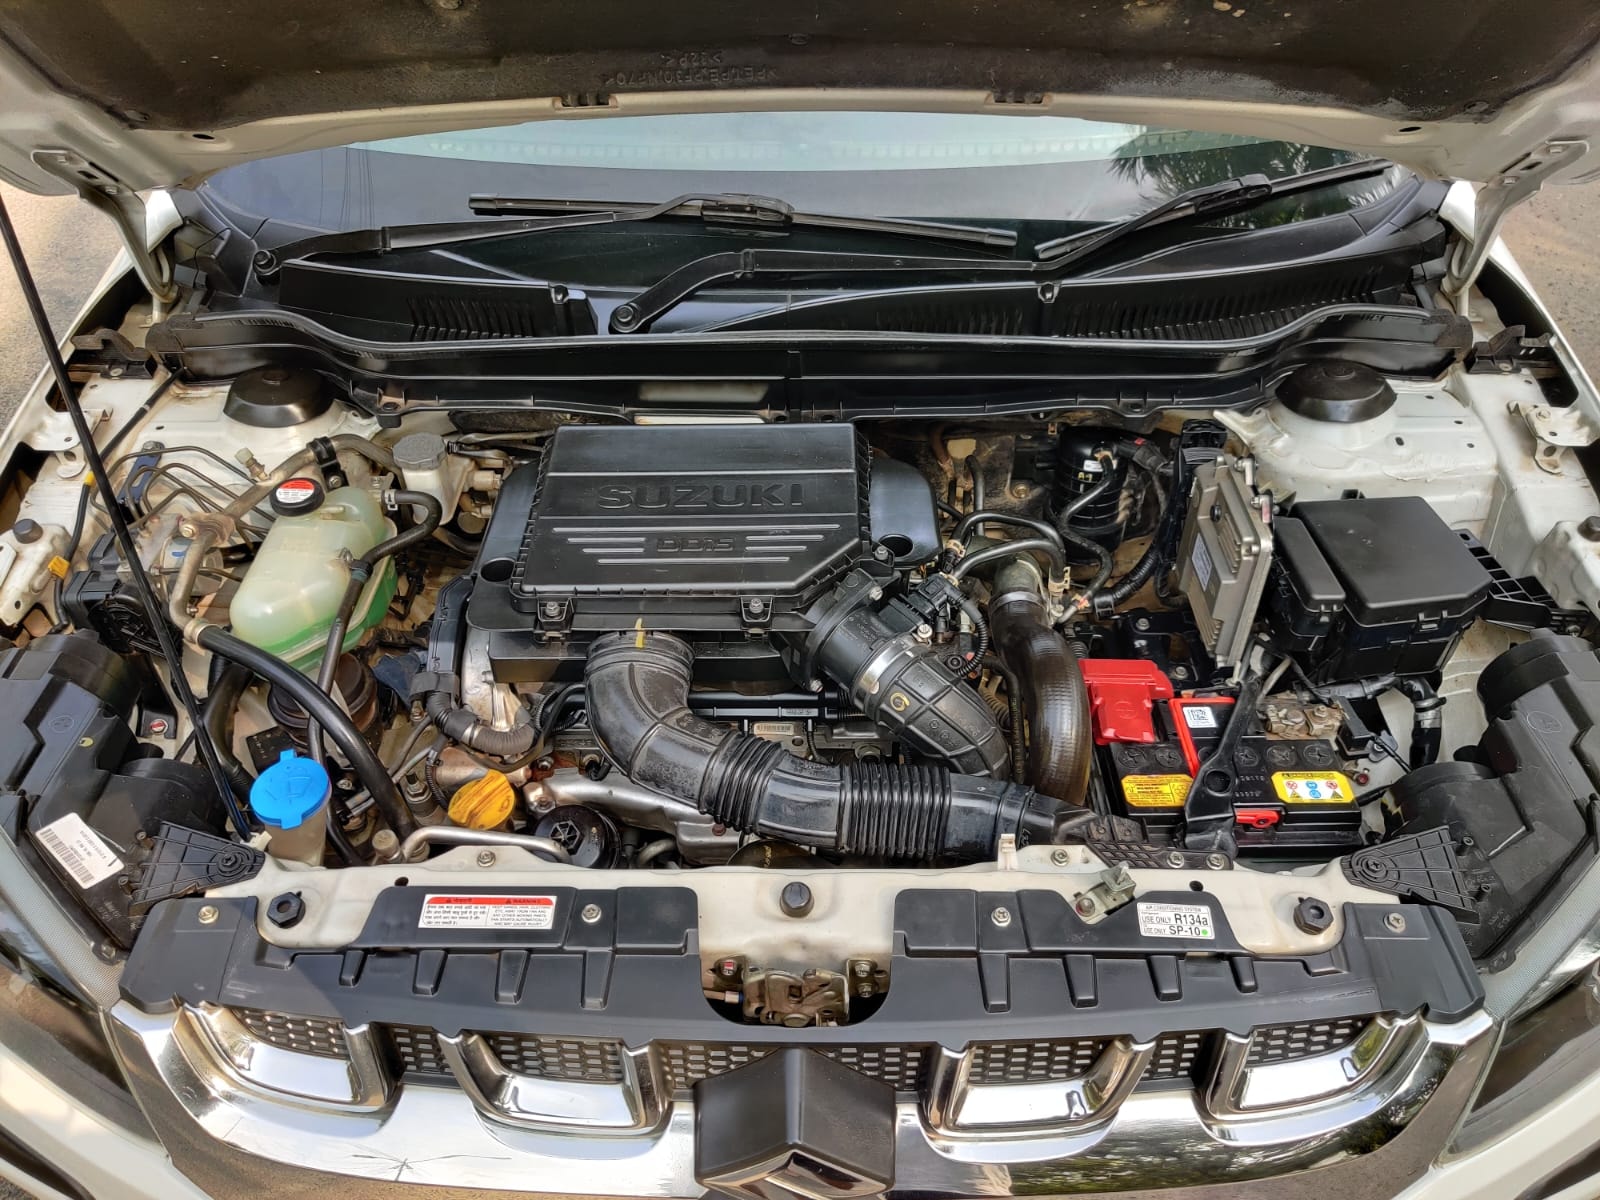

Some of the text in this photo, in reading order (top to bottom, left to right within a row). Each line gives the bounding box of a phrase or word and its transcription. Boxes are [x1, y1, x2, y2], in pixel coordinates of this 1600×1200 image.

[598, 484, 804, 509] SUZUKI
[1156, 916, 1172, 924] ONLY
[1174, 913, 1208, 926] R134a
[1169, 925, 1201, 936] SP-10
